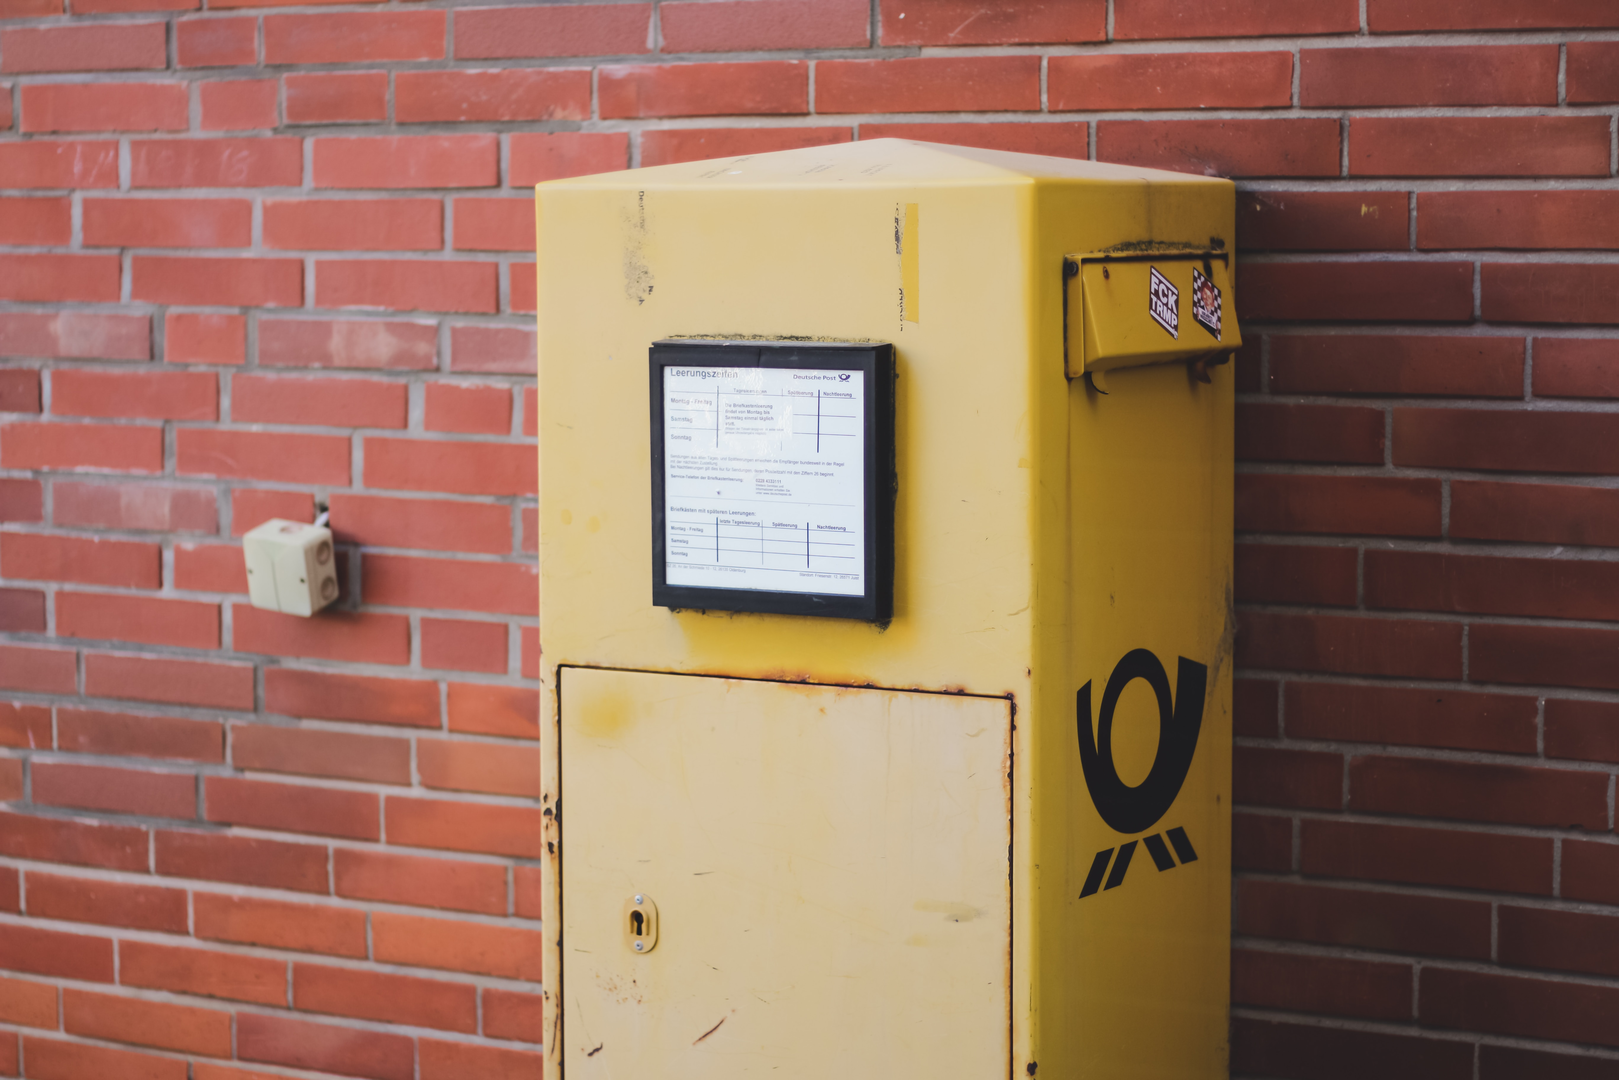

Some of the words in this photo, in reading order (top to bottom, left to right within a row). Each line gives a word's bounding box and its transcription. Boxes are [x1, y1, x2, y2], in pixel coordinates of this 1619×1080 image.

[1151, 274, 1178, 315] FCK
[1150, 293, 1178, 328] TRMP
[671, 416, 693, 424] Samstag
[671, 434, 692, 442] Sonntag
